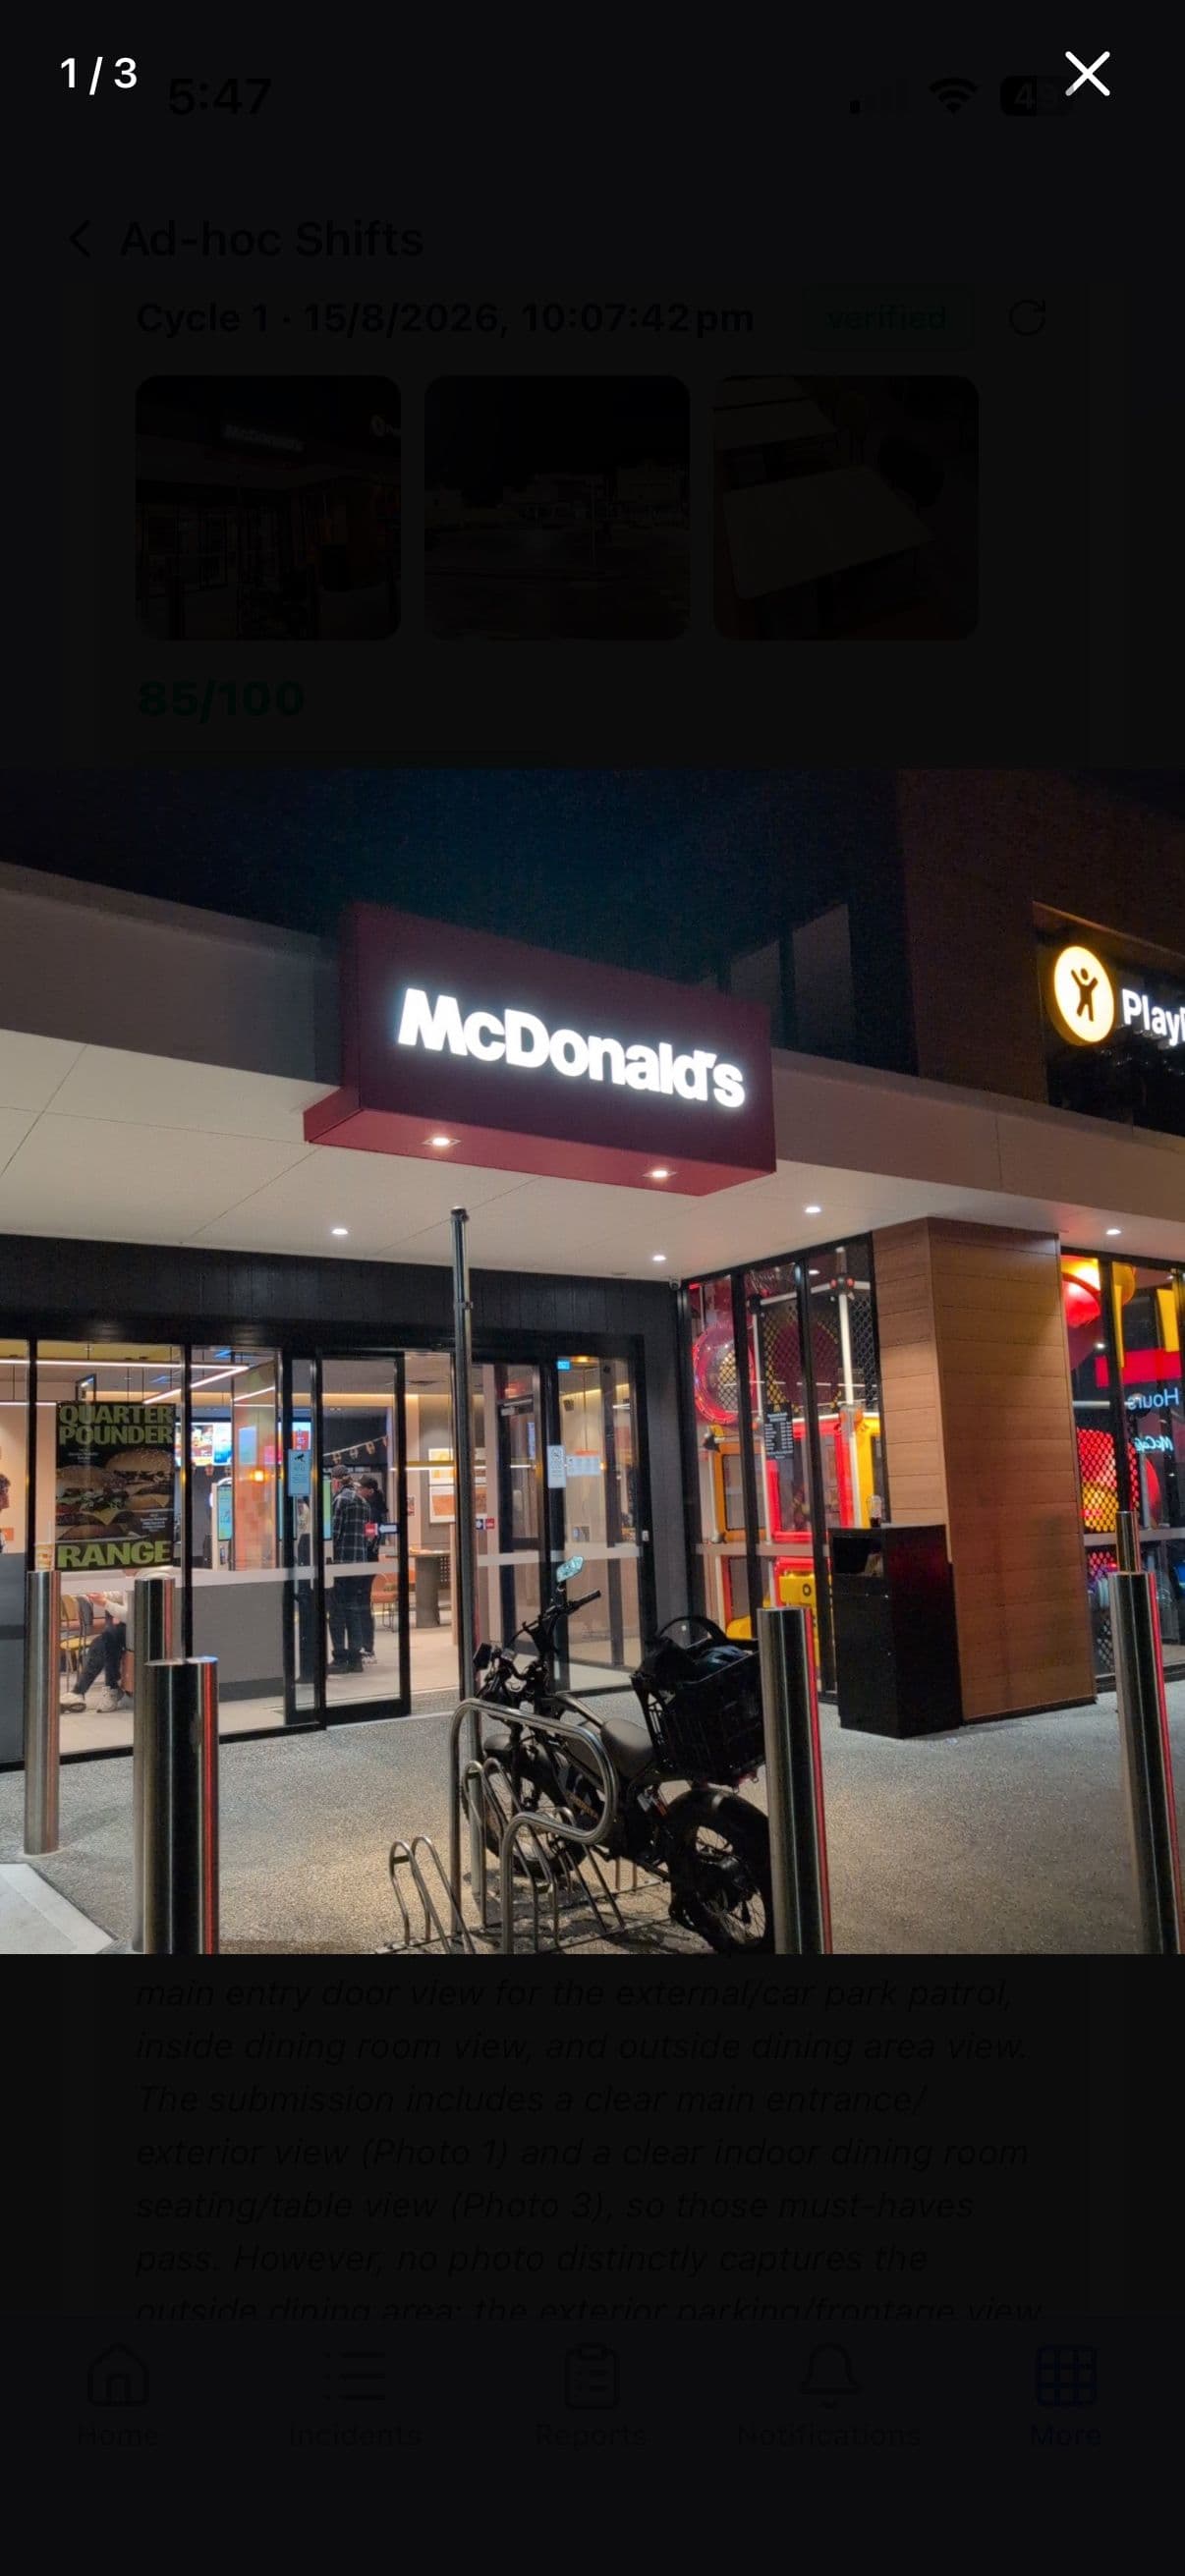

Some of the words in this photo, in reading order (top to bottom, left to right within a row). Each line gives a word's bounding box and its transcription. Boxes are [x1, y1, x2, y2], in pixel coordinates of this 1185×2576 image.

[398, 987, 747, 1109] McDonald's
[59, 1405, 173, 1428] QUARTER
[59, 1425, 173, 1445] POUNDER
[57, 1540, 172, 1568] RANGE
